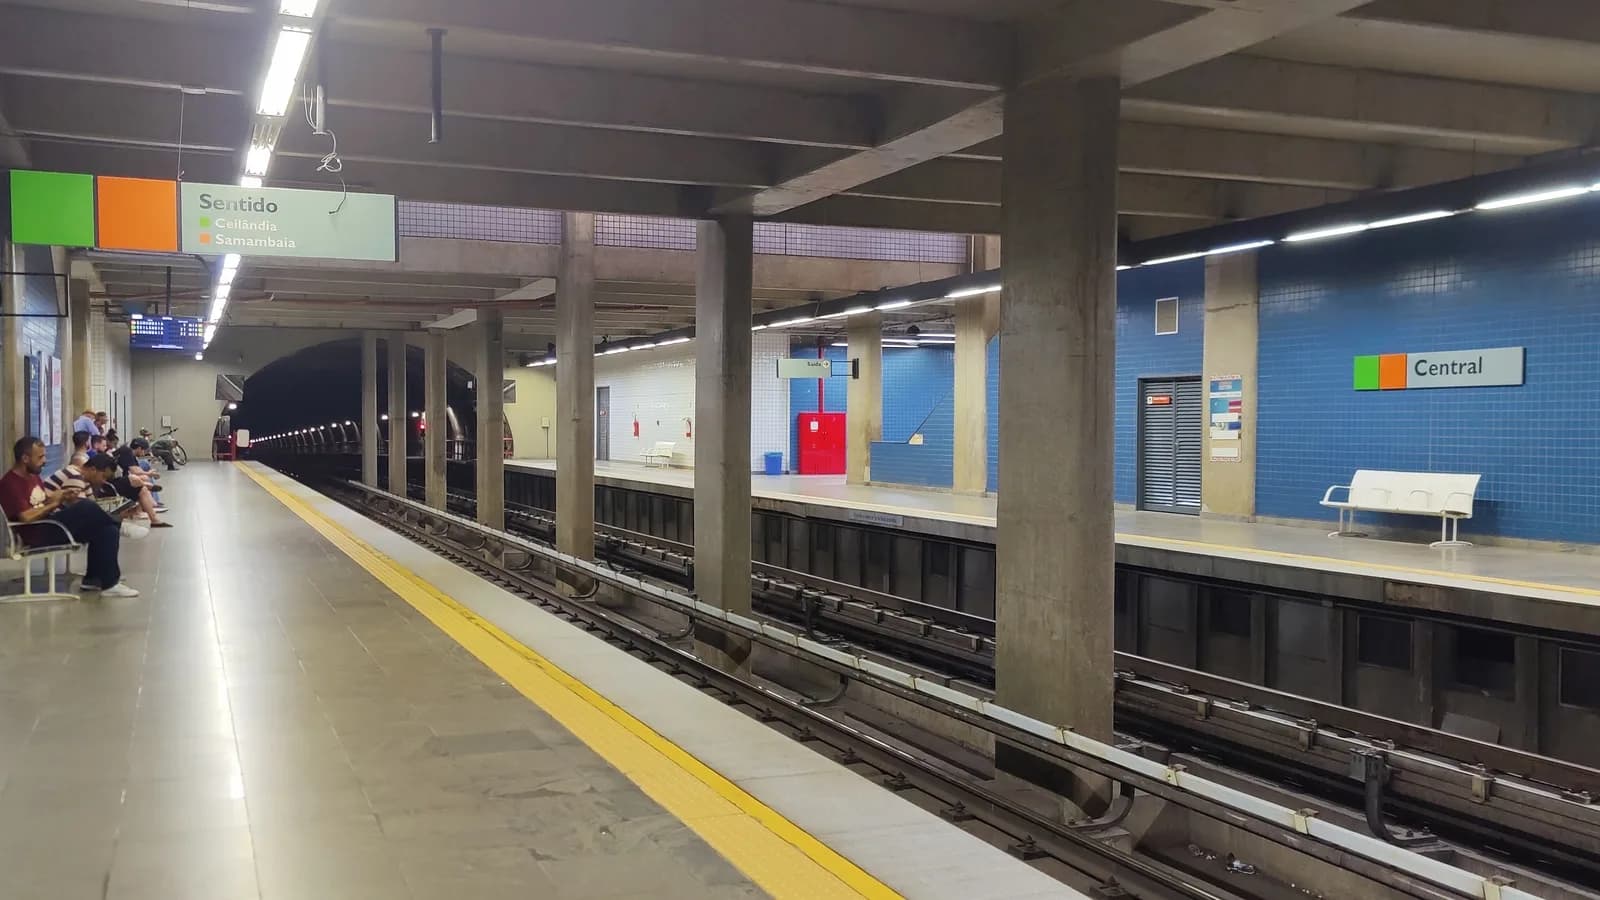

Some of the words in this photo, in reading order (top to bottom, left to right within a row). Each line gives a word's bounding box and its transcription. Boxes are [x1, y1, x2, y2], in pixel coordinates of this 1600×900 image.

[199, 193, 278, 213] Sentido
[215, 218, 278, 232] Ceilândia
[215, 233, 296, 249] Samambaia
[1414, 356, 1482, 376] Central
